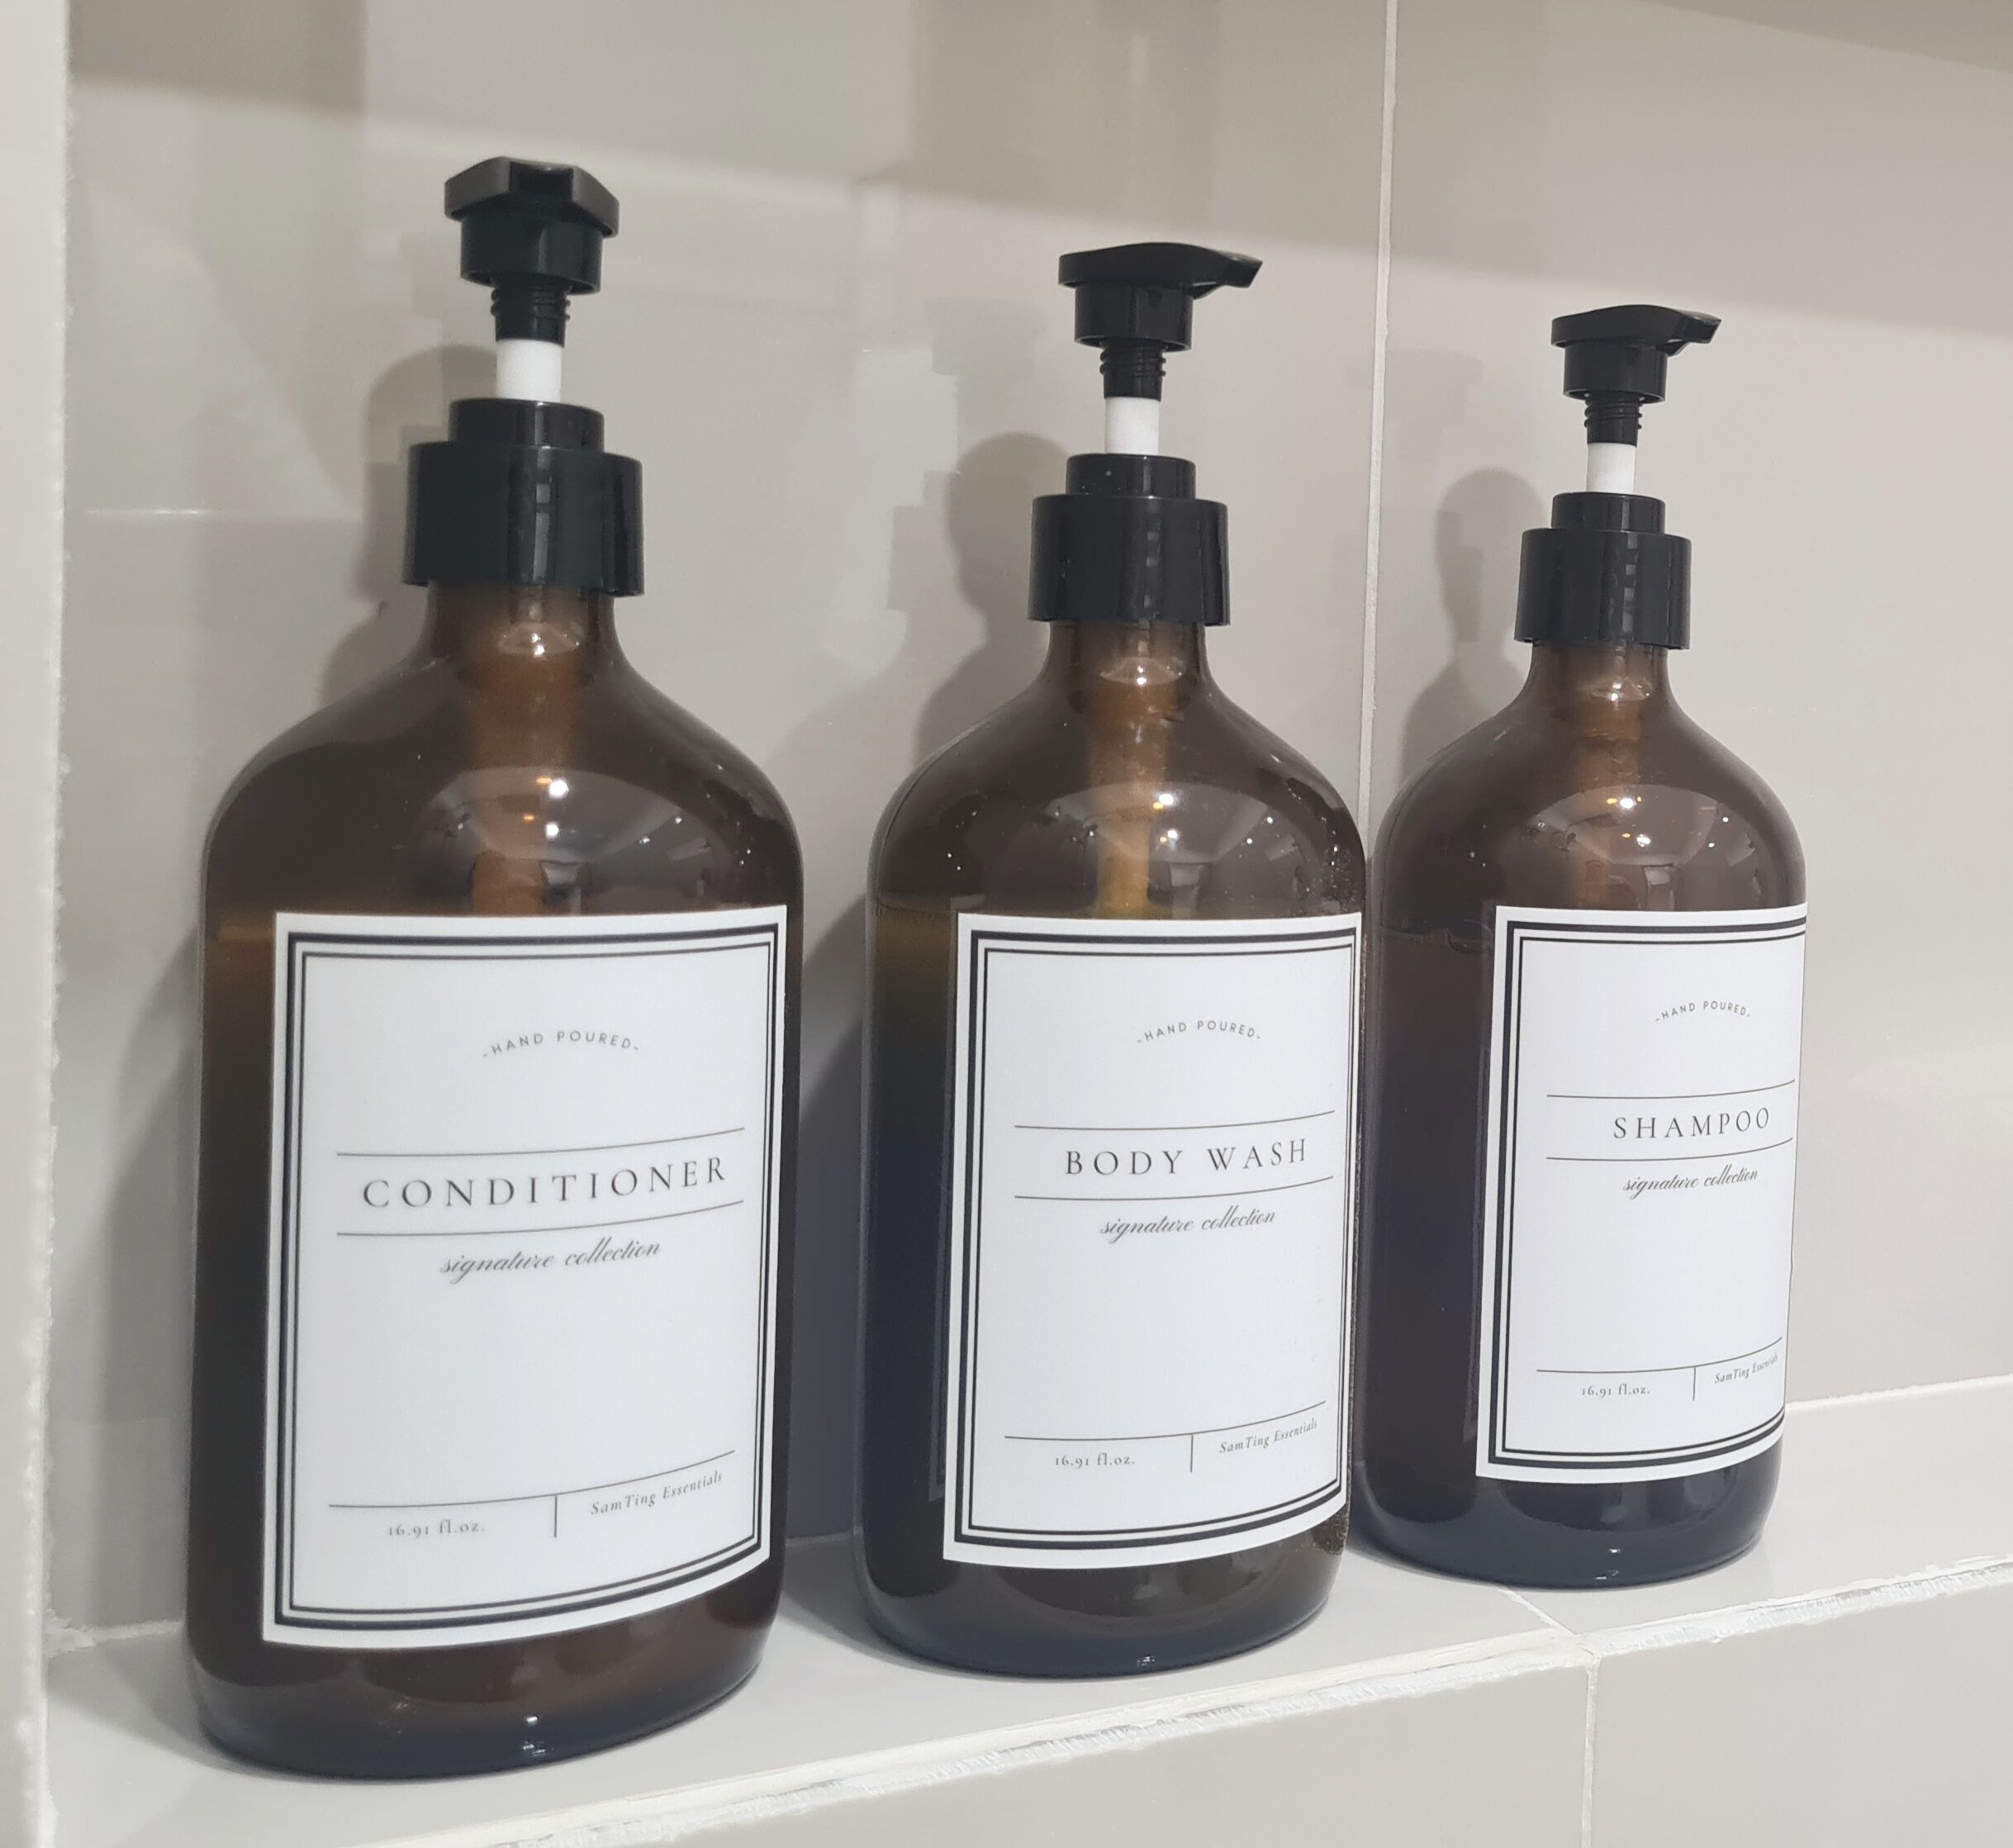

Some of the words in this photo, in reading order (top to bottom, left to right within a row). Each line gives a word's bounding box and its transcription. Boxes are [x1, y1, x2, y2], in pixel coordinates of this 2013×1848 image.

[1614, 1108, 1768, 1139] SHAMPOO
[1064, 1150, 1184, 1176] BODY
[1206, 1138, 1305, 1171] WASH
[361, 1155, 727, 1209] CONDITIONER
[1622, 1174, 1699, 1200] signature
[1704, 1163, 1758, 1187] collection
[1099, 1215, 1195, 1245] signature
[1201, 1204, 1275, 1230] collection
[439, 1251, 555, 1285] signature
[564, 1236, 661, 1266] collection
[1581, 1385, 1612, 1399] 16.91
[1618, 1383, 1650, 1395] fl.oz.
[1273, 1418, 1317, 1442] Essentials
[1055, 1454, 1090, 1470] 16.91
[1097, 1452, 1135, 1466] fl.oz.
[659, 1466, 722, 1499] Essentials
[662, 1469, 723, 1500] Essentials
[387, 1523, 430, 1540] 16.91
[438, 1519, 485, 1535] fl.oz.
